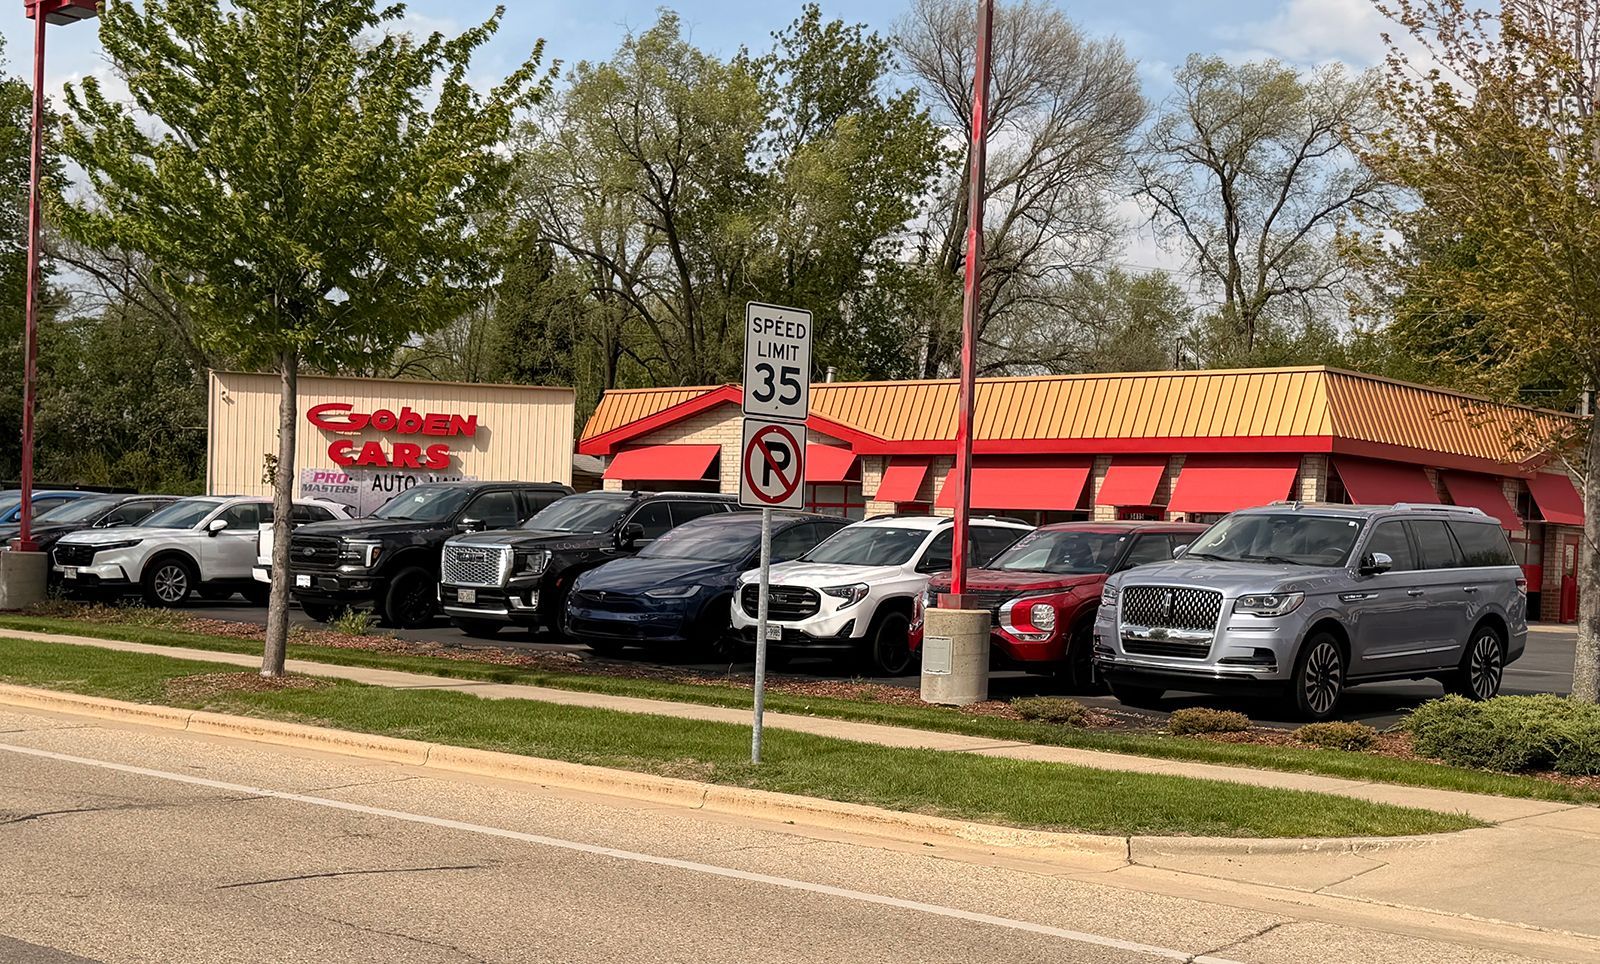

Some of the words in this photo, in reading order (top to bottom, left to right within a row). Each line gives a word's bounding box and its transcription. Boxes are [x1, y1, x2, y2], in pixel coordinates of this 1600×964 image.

[753, 317, 806, 339] SPEED
[758, 341, 799, 361] LIMIT
[752, 363, 802, 405] 35
[328, 439, 451, 469] CARS
[762, 441, 791, 487] P
[313, 472, 349, 484] PRO
[371, 474, 416, 492] AUTO
[302, 484, 359, 494] MASTERS
